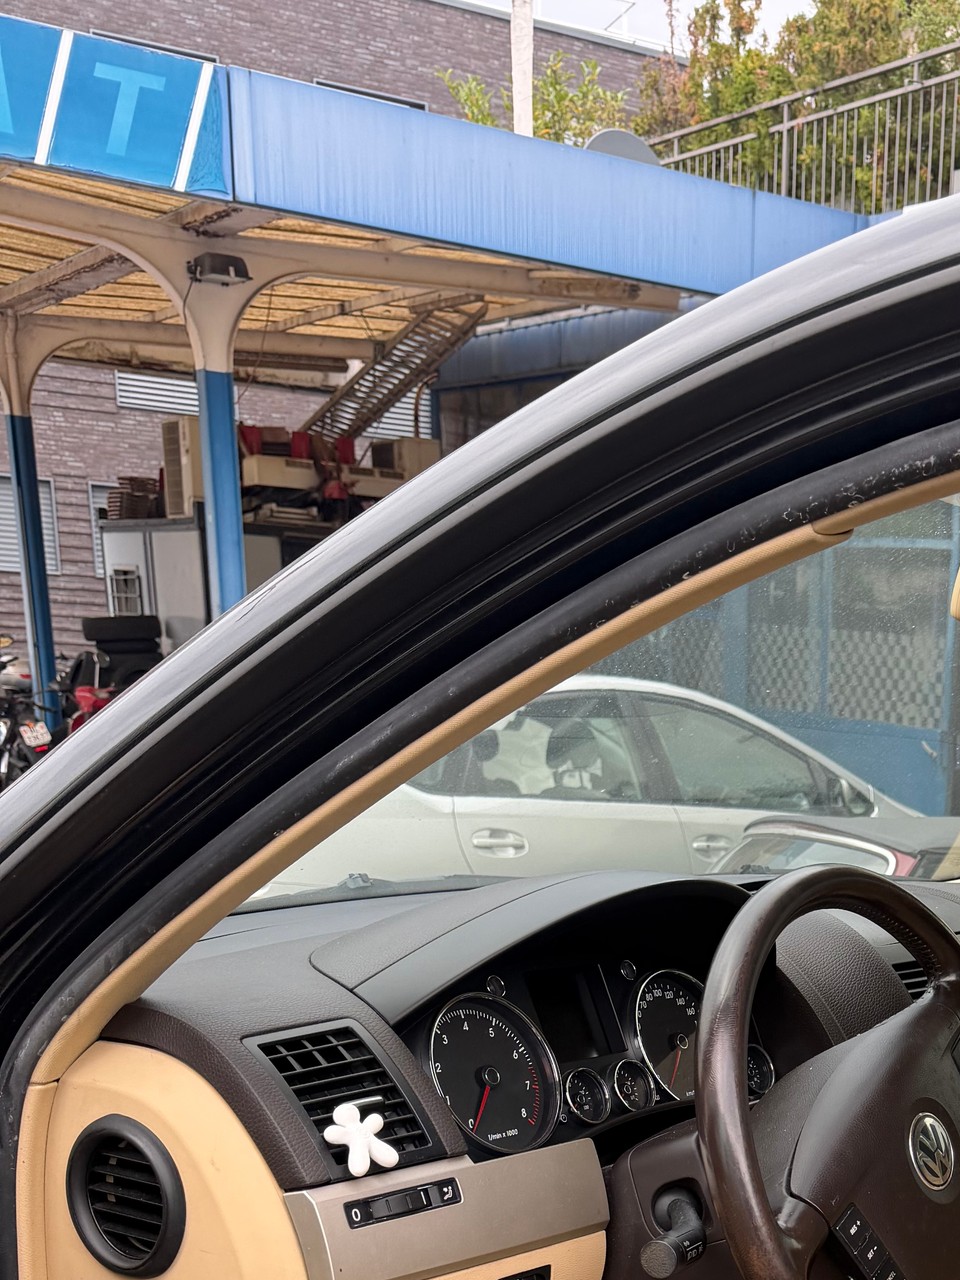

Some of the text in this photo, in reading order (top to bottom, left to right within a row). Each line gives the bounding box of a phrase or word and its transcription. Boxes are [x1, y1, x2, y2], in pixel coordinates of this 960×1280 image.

[462, 1021, 469, 1031] 4
[488, 1028, 495, 1038] 5
[442, 1035, 448, 1045] 3
[512, 1050, 519, 1060] 6
[435, 1063, 442, 1073] 2
[525, 1080, 530, 1090] 7
[521, 1108, 527, 1118] 8
[468, 1118, 475, 1129] 0
[506, 1129, 519, 1138] 1000
[351, 1208, 361, 1222] 0
